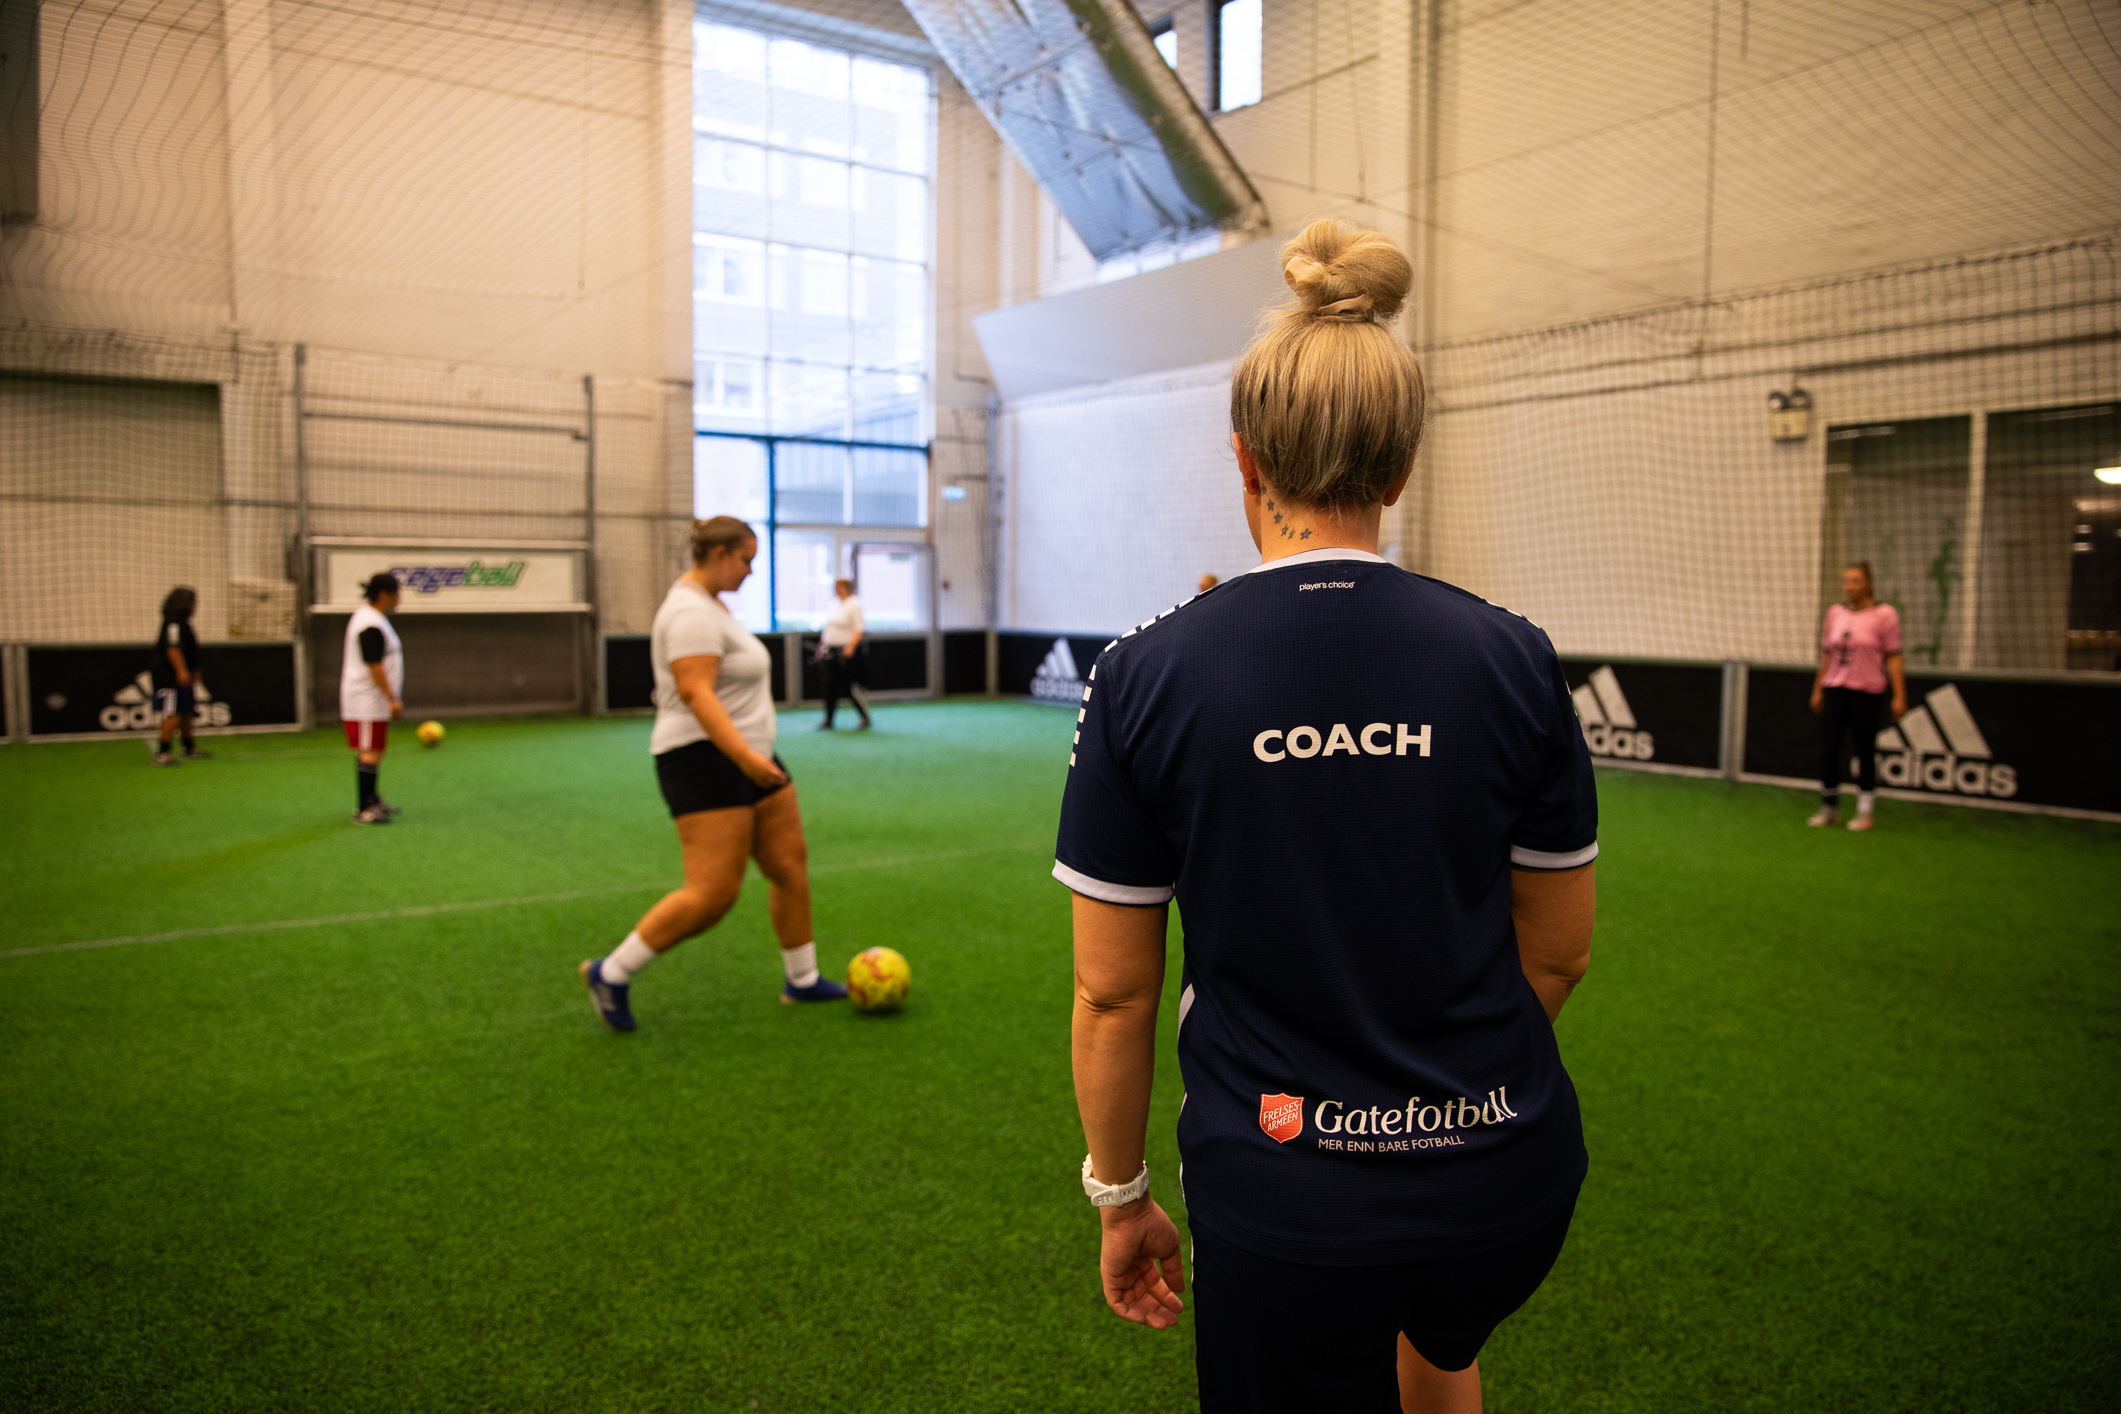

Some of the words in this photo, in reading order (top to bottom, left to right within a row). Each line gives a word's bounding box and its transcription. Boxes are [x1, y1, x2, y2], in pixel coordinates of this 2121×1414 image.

[1253, 722, 1432, 763] COACH
[1267, 1111, 1299, 1132] ARMEEN
[1318, 1138, 1344, 1151] MER
[1347, 1140, 1375, 1152] ENN
[1378, 1139, 1410, 1153] BARE
[1411, 1135, 1465, 1150] FOTBALL
